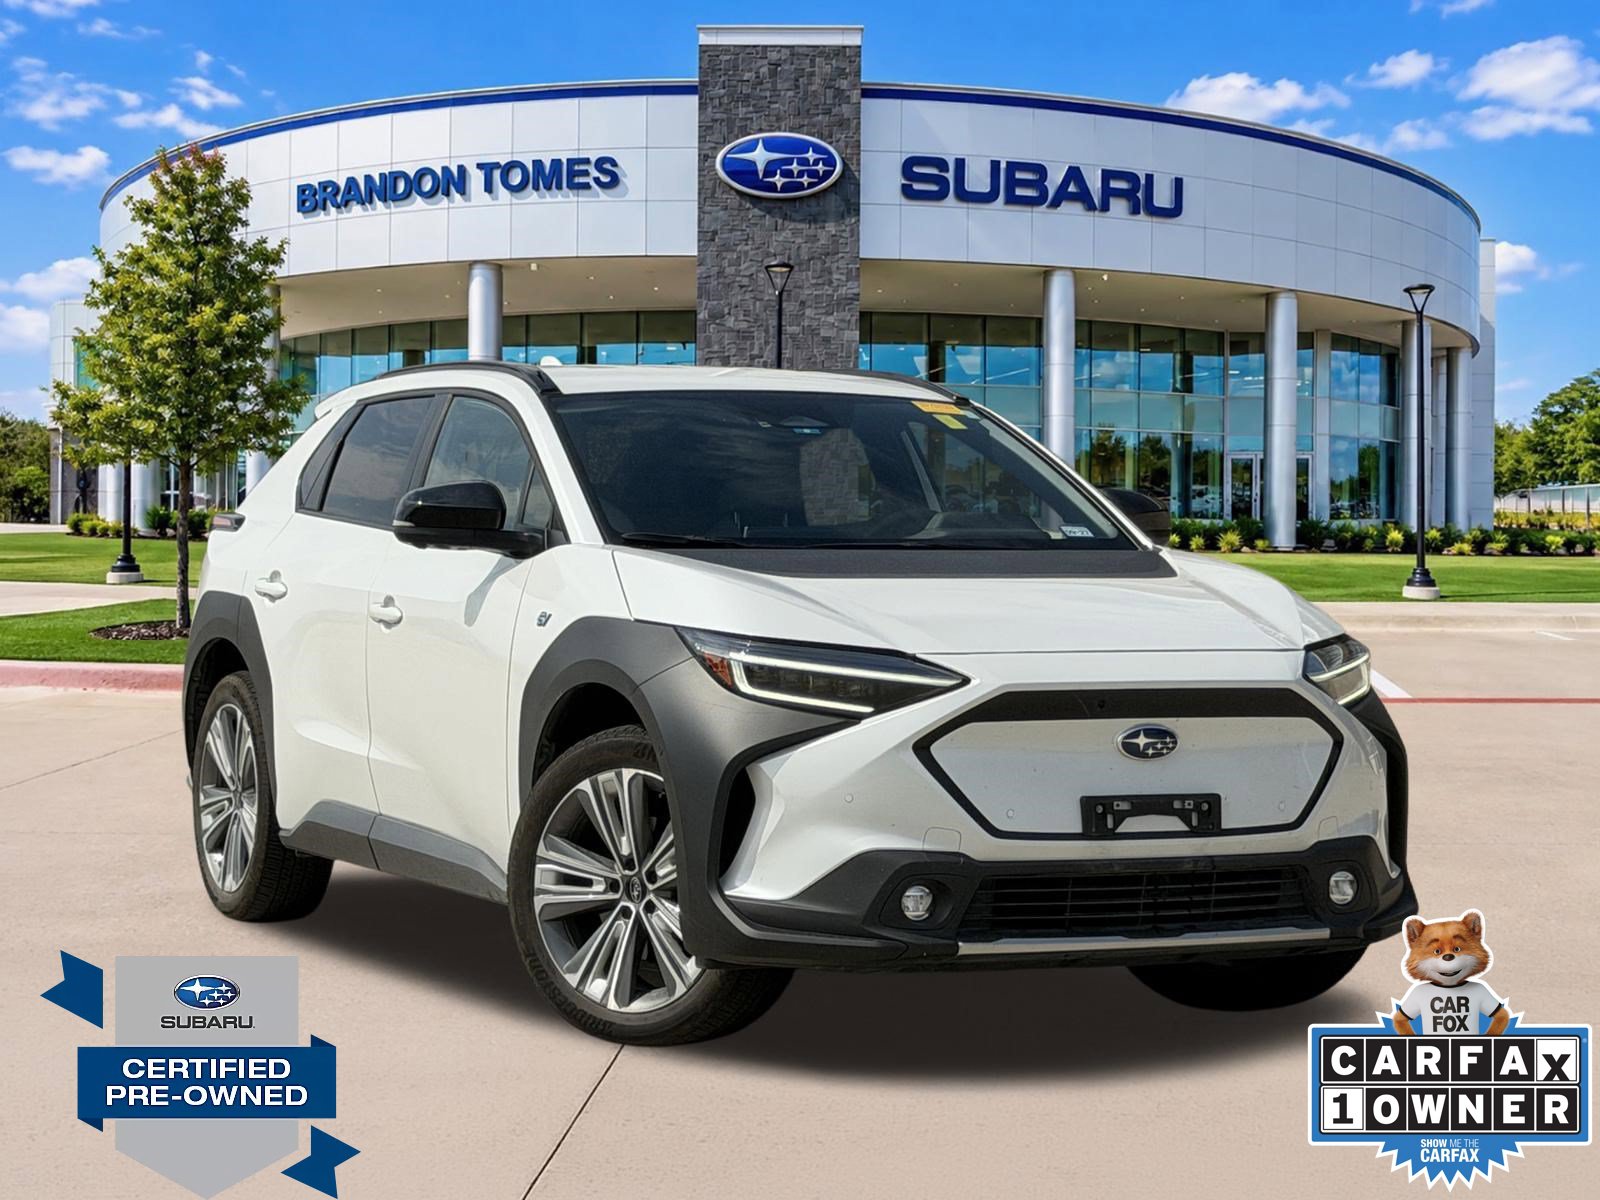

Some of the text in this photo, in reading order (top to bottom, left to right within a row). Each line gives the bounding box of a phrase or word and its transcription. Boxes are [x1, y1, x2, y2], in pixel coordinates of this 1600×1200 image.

[296, 156, 620, 213] BRANDON TOMES
[901, 155, 1184, 218] SUBARU
